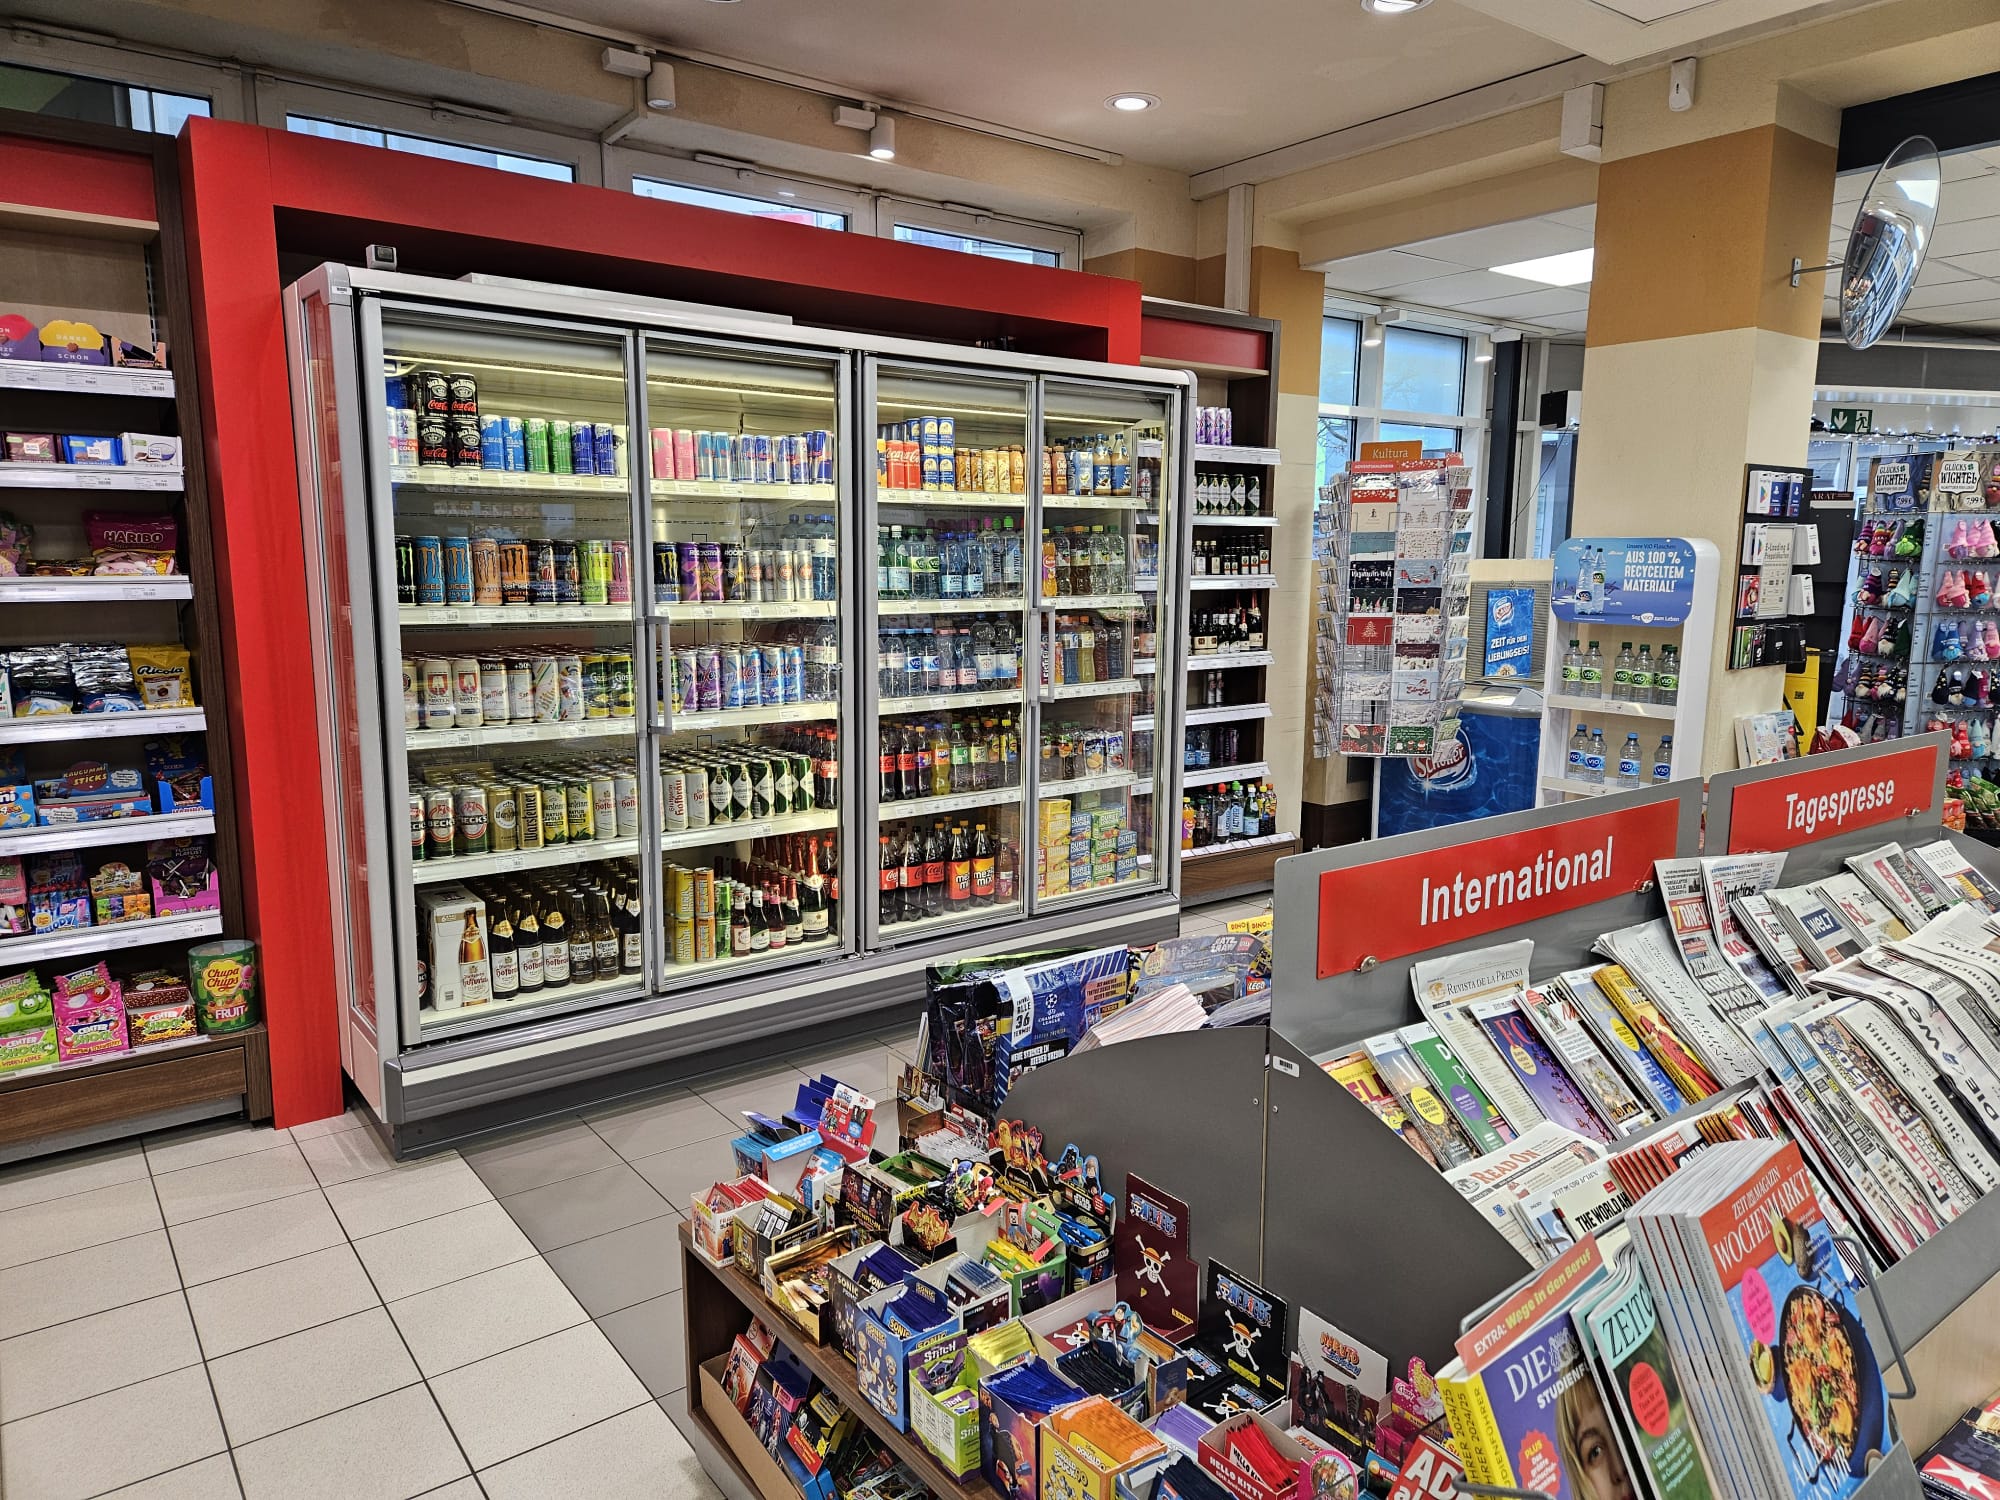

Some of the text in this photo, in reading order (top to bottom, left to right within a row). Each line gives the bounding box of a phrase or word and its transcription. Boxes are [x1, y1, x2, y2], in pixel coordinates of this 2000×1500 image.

[1372, 449, 1409, 460] Kultura
[103, 530, 164, 544] HARIBO
[1624, 564, 1685, 579] RECYCELTEM
[1625, 550, 1681, 564] AUS 100 %
[1487, 645, 1530, 663] LIEBLINGSEIS!
[1490, 636, 1507, 649] ZEIT
[136, 664, 185, 676] Ricola
[524, 792, 536, 842] Warsteiner
[1785, 777, 1896, 835] Tagespresse
[1419, 835, 1615, 927] International
[206, 977, 239, 990] Chups
[207, 967, 240, 979] Chupa
[1247, 981, 1266, 992] LEGO
[1446, 978, 1477, 997] REVISTA
[1495, 967, 1523, 984] PRENSA
[215, 1005, 245, 1020] FRUIT
[1015, 1012, 1030, 1030] 36
[1038, 1011, 1066, 1023] CHAMPIONS
[1042, 1018, 1060, 1026] LEAGUE
[1654, 972, 1748, 1081] iplomatique
[1865, 1021, 1916, 1080] Zeitung
[1964, 1077, 2000, 1121] DIE
[1917, 1084, 1968, 1146] Zürcher
[1860, 1087, 1951, 1205] Hürriyet
[1470, 1148, 1542, 1185] READ ON
[1731, 1165, 1781, 1221] ZEIT MAGAZIN
[1575, 1211, 1596, 1233] THE
[1593, 1198, 1623, 1225] WORLD
[1712, 1167, 1812, 1274] WOCHENMARKT
[837, 1273, 859, 1298] SONIC
[1473, 1247, 1593, 1358] EXTRA: Wege in den Beruf
[889, 1317, 912, 1339] SONIC
[1320, 1331, 1360, 1365] NARUTO
[1503, 1344, 1553, 1403] DIE
[1443, 1388, 1465, 1437] 2024/25
[1457, 1392, 1481, 1442] 2024/25
[1232, 1447, 1250, 1473] HELLO
[1523, 1438, 1543, 1459] PLUS
[1209, 1456, 1264, 1499] HELLO KITTY
